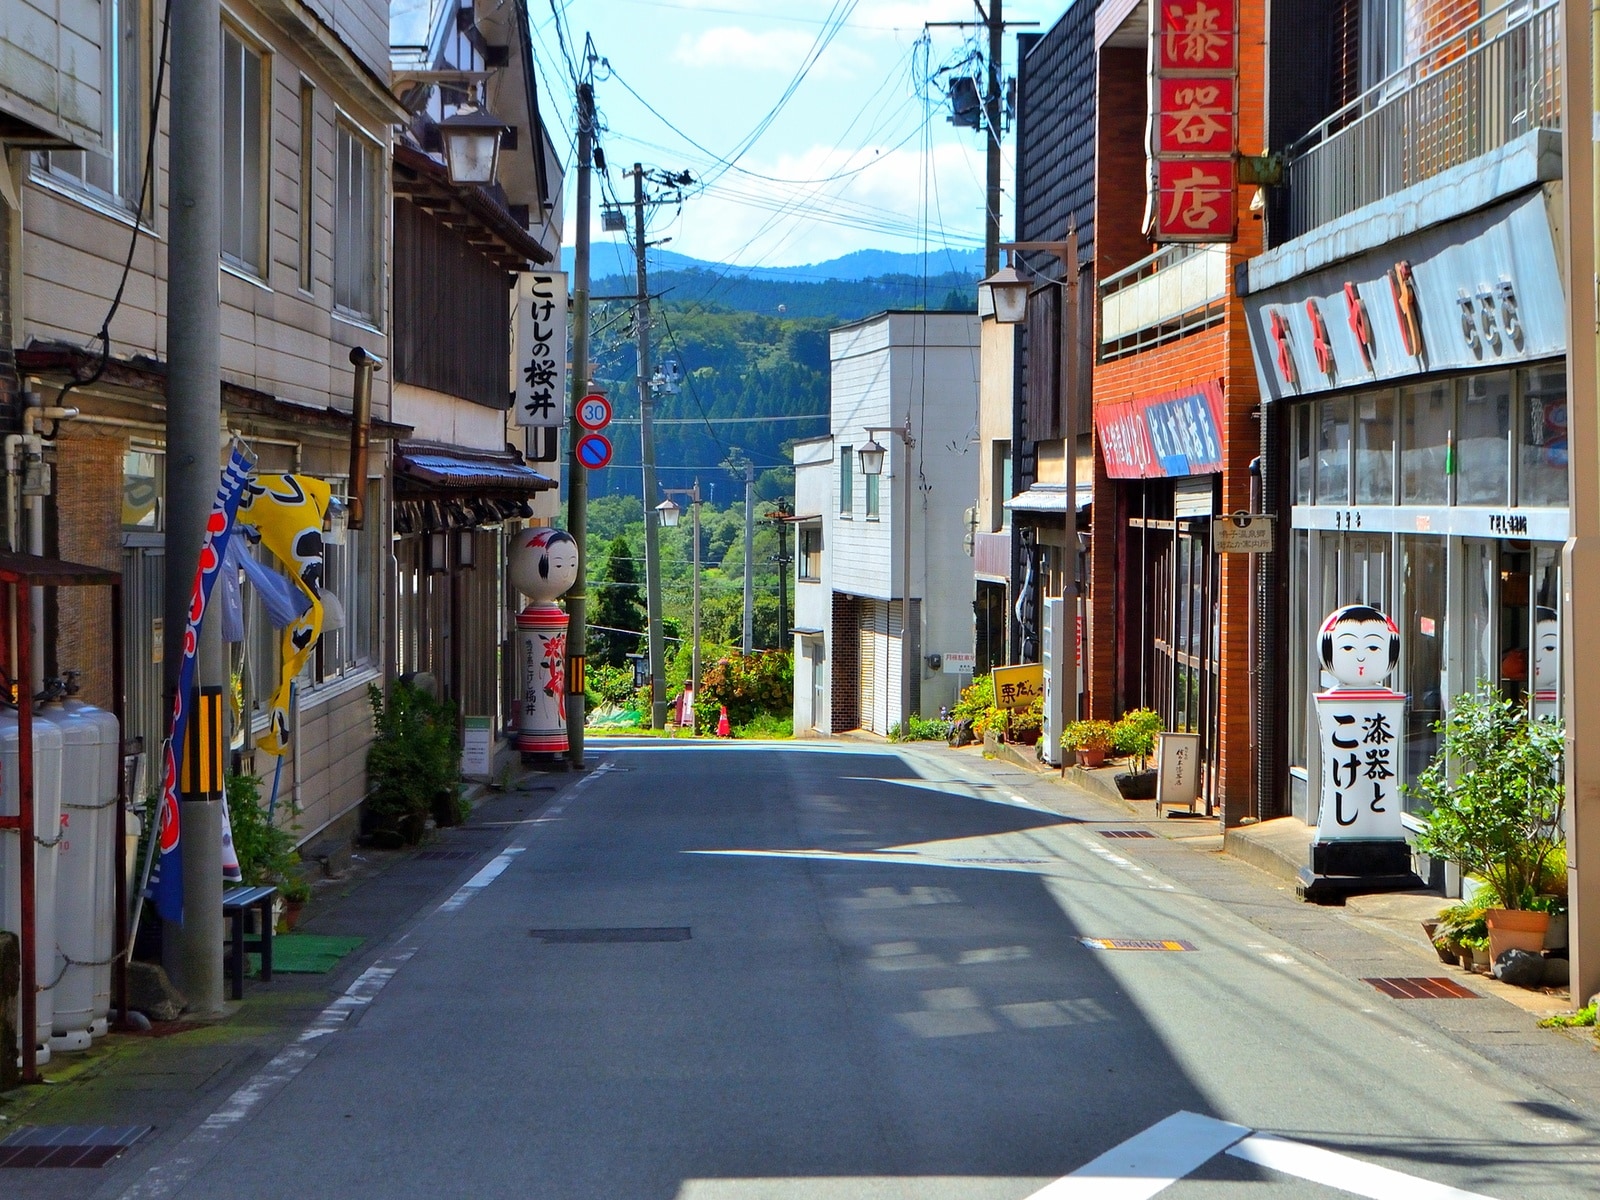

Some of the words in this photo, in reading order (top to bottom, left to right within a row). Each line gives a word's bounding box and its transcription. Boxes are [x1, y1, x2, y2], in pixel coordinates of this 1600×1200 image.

[1165, 2, 1229, 229] 漆器店
[523, 275, 558, 419] こけしの桜井
[584, 405, 604, 420] 30
[1331, 714, 1362, 827] こけし
[1362, 713, 1395, 813] 漆器と
